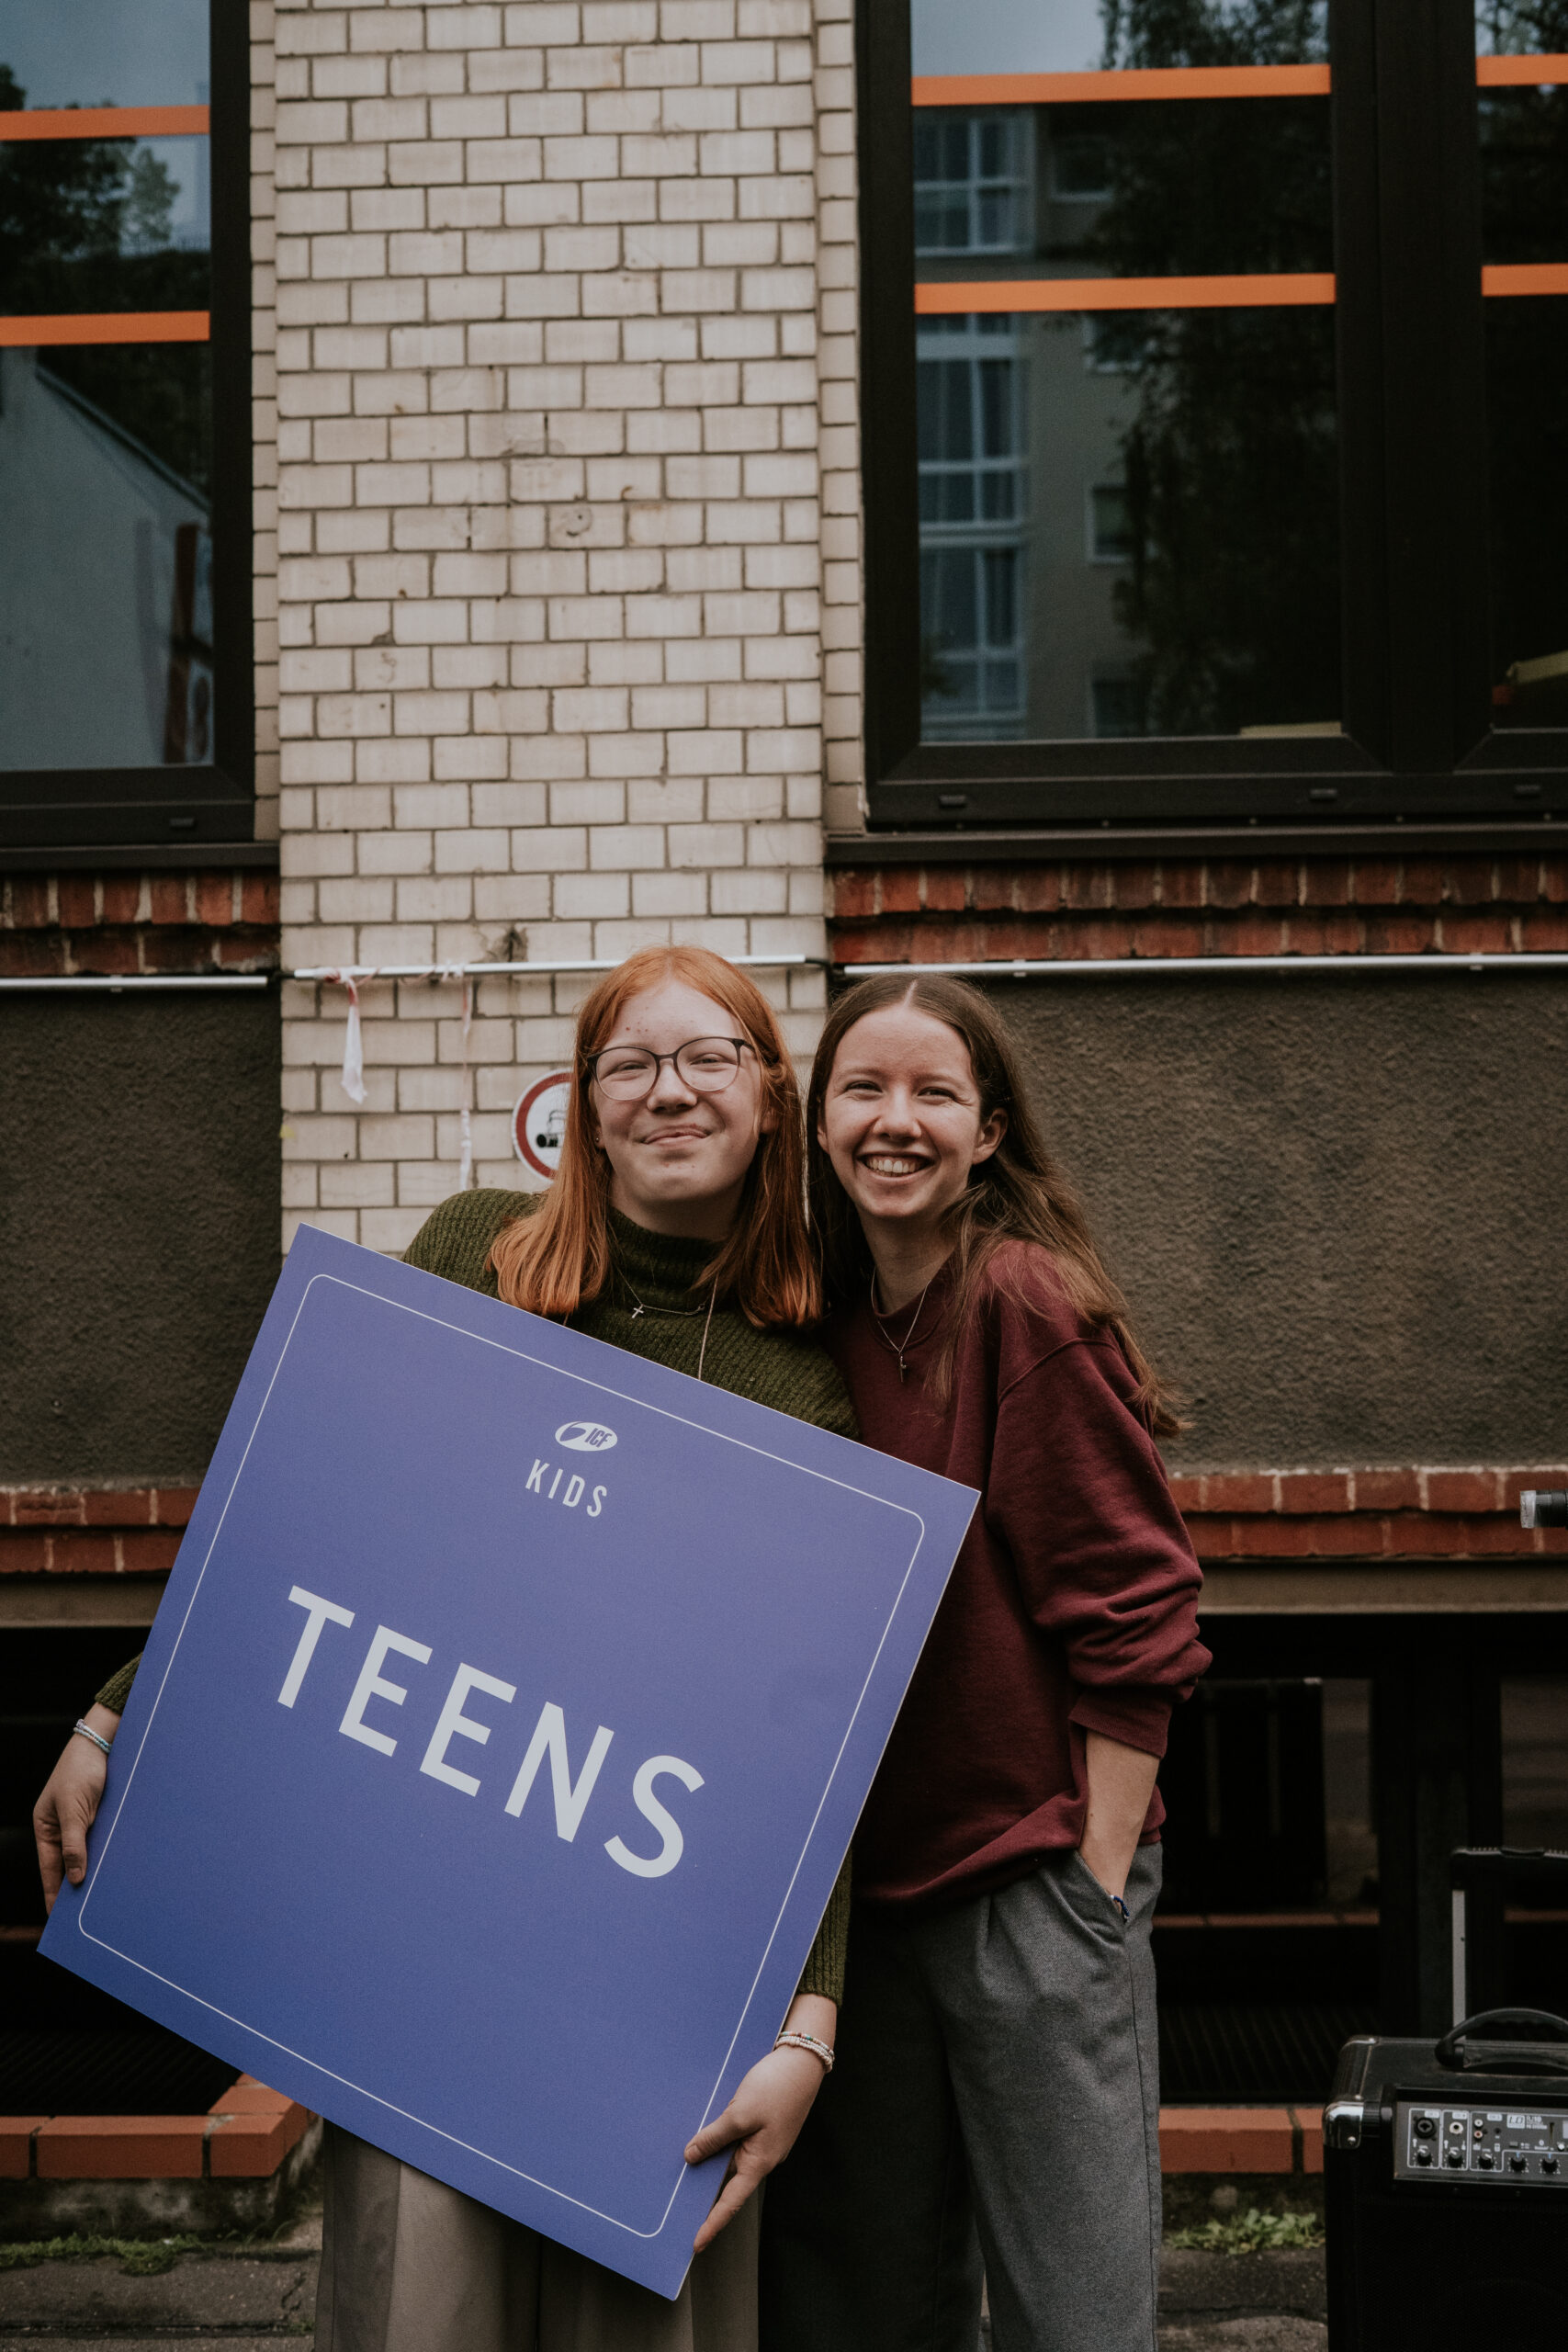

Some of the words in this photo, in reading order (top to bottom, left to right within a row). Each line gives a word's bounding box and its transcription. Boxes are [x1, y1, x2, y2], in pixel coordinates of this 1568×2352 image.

[584, 1428, 613, 1448] ICF
[525, 1458, 607, 1518] KIDS
[277, 1585, 705, 1878] TEENS
